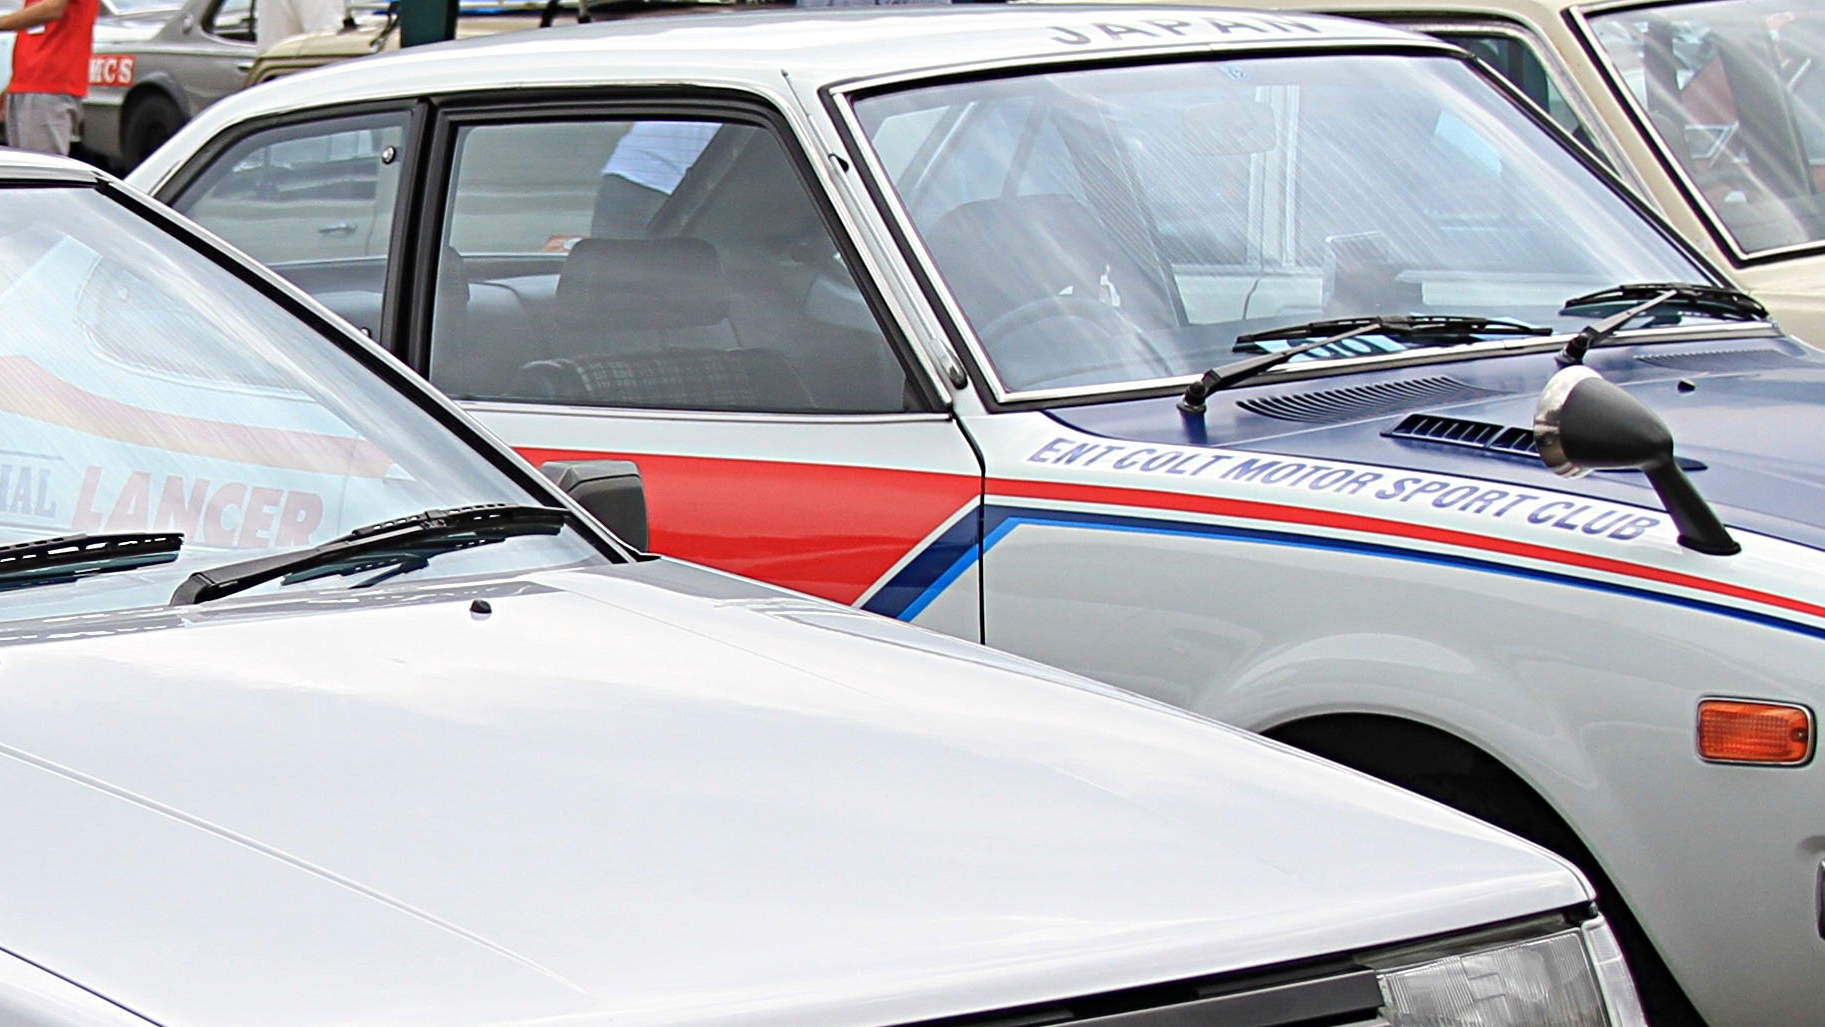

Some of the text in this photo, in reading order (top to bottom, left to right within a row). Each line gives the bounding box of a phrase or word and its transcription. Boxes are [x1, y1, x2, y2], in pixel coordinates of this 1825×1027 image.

[1048, 16, 1323, 45] JAPAN
[70, 465, 324, 549] LANCER
[1026, 437, 1661, 541] ENT COLT MOTOR SPORT CLUB
